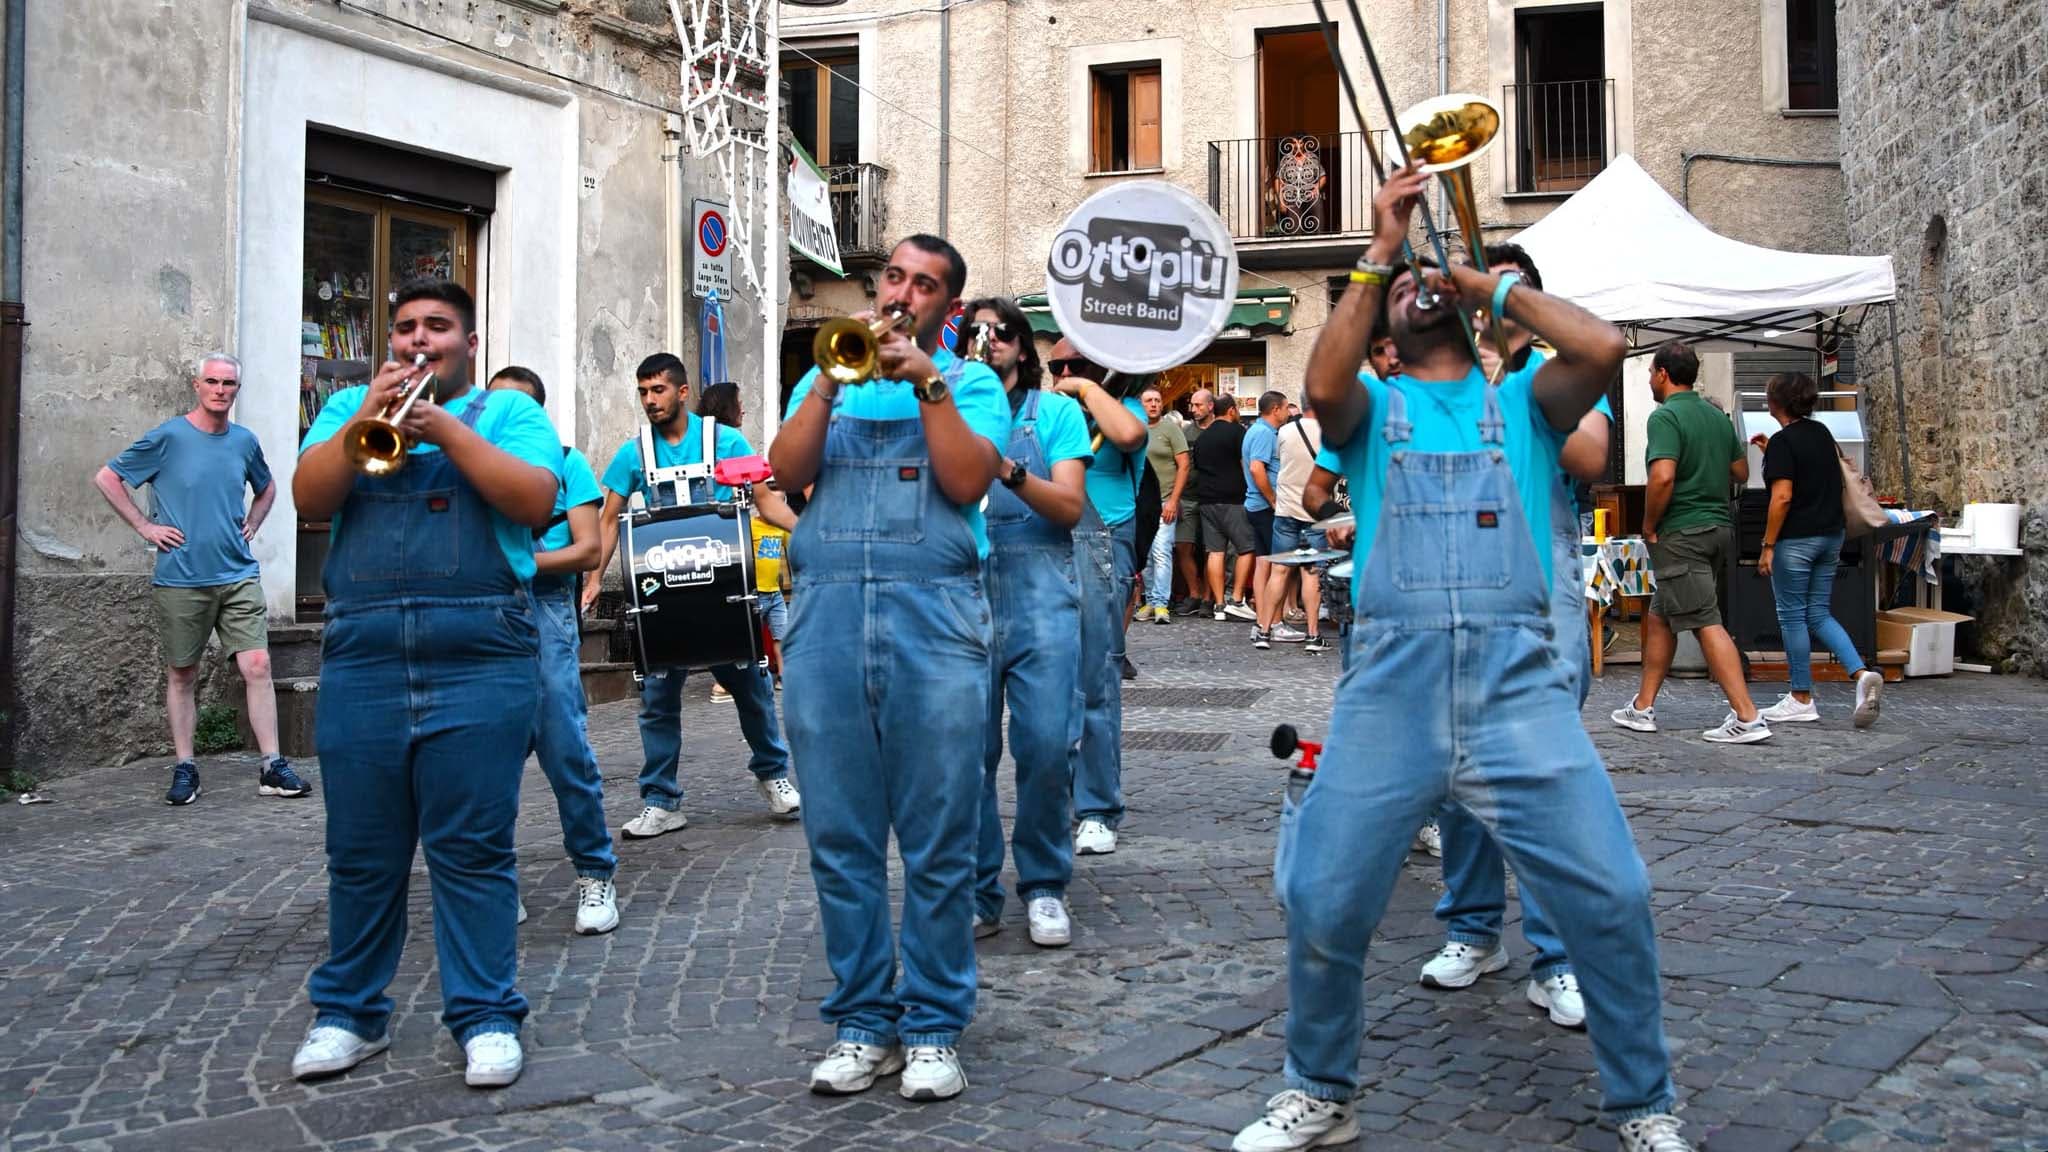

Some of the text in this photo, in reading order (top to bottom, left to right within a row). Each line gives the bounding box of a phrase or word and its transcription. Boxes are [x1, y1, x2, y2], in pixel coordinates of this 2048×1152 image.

[711, 262, 723, 272] tutta
[1049, 229, 1227, 300] Ottopiù
[698, 272, 711, 282] Largo
[1084, 297, 1179, 321] Street Band
[667, 570, 711, 582] Street Band
